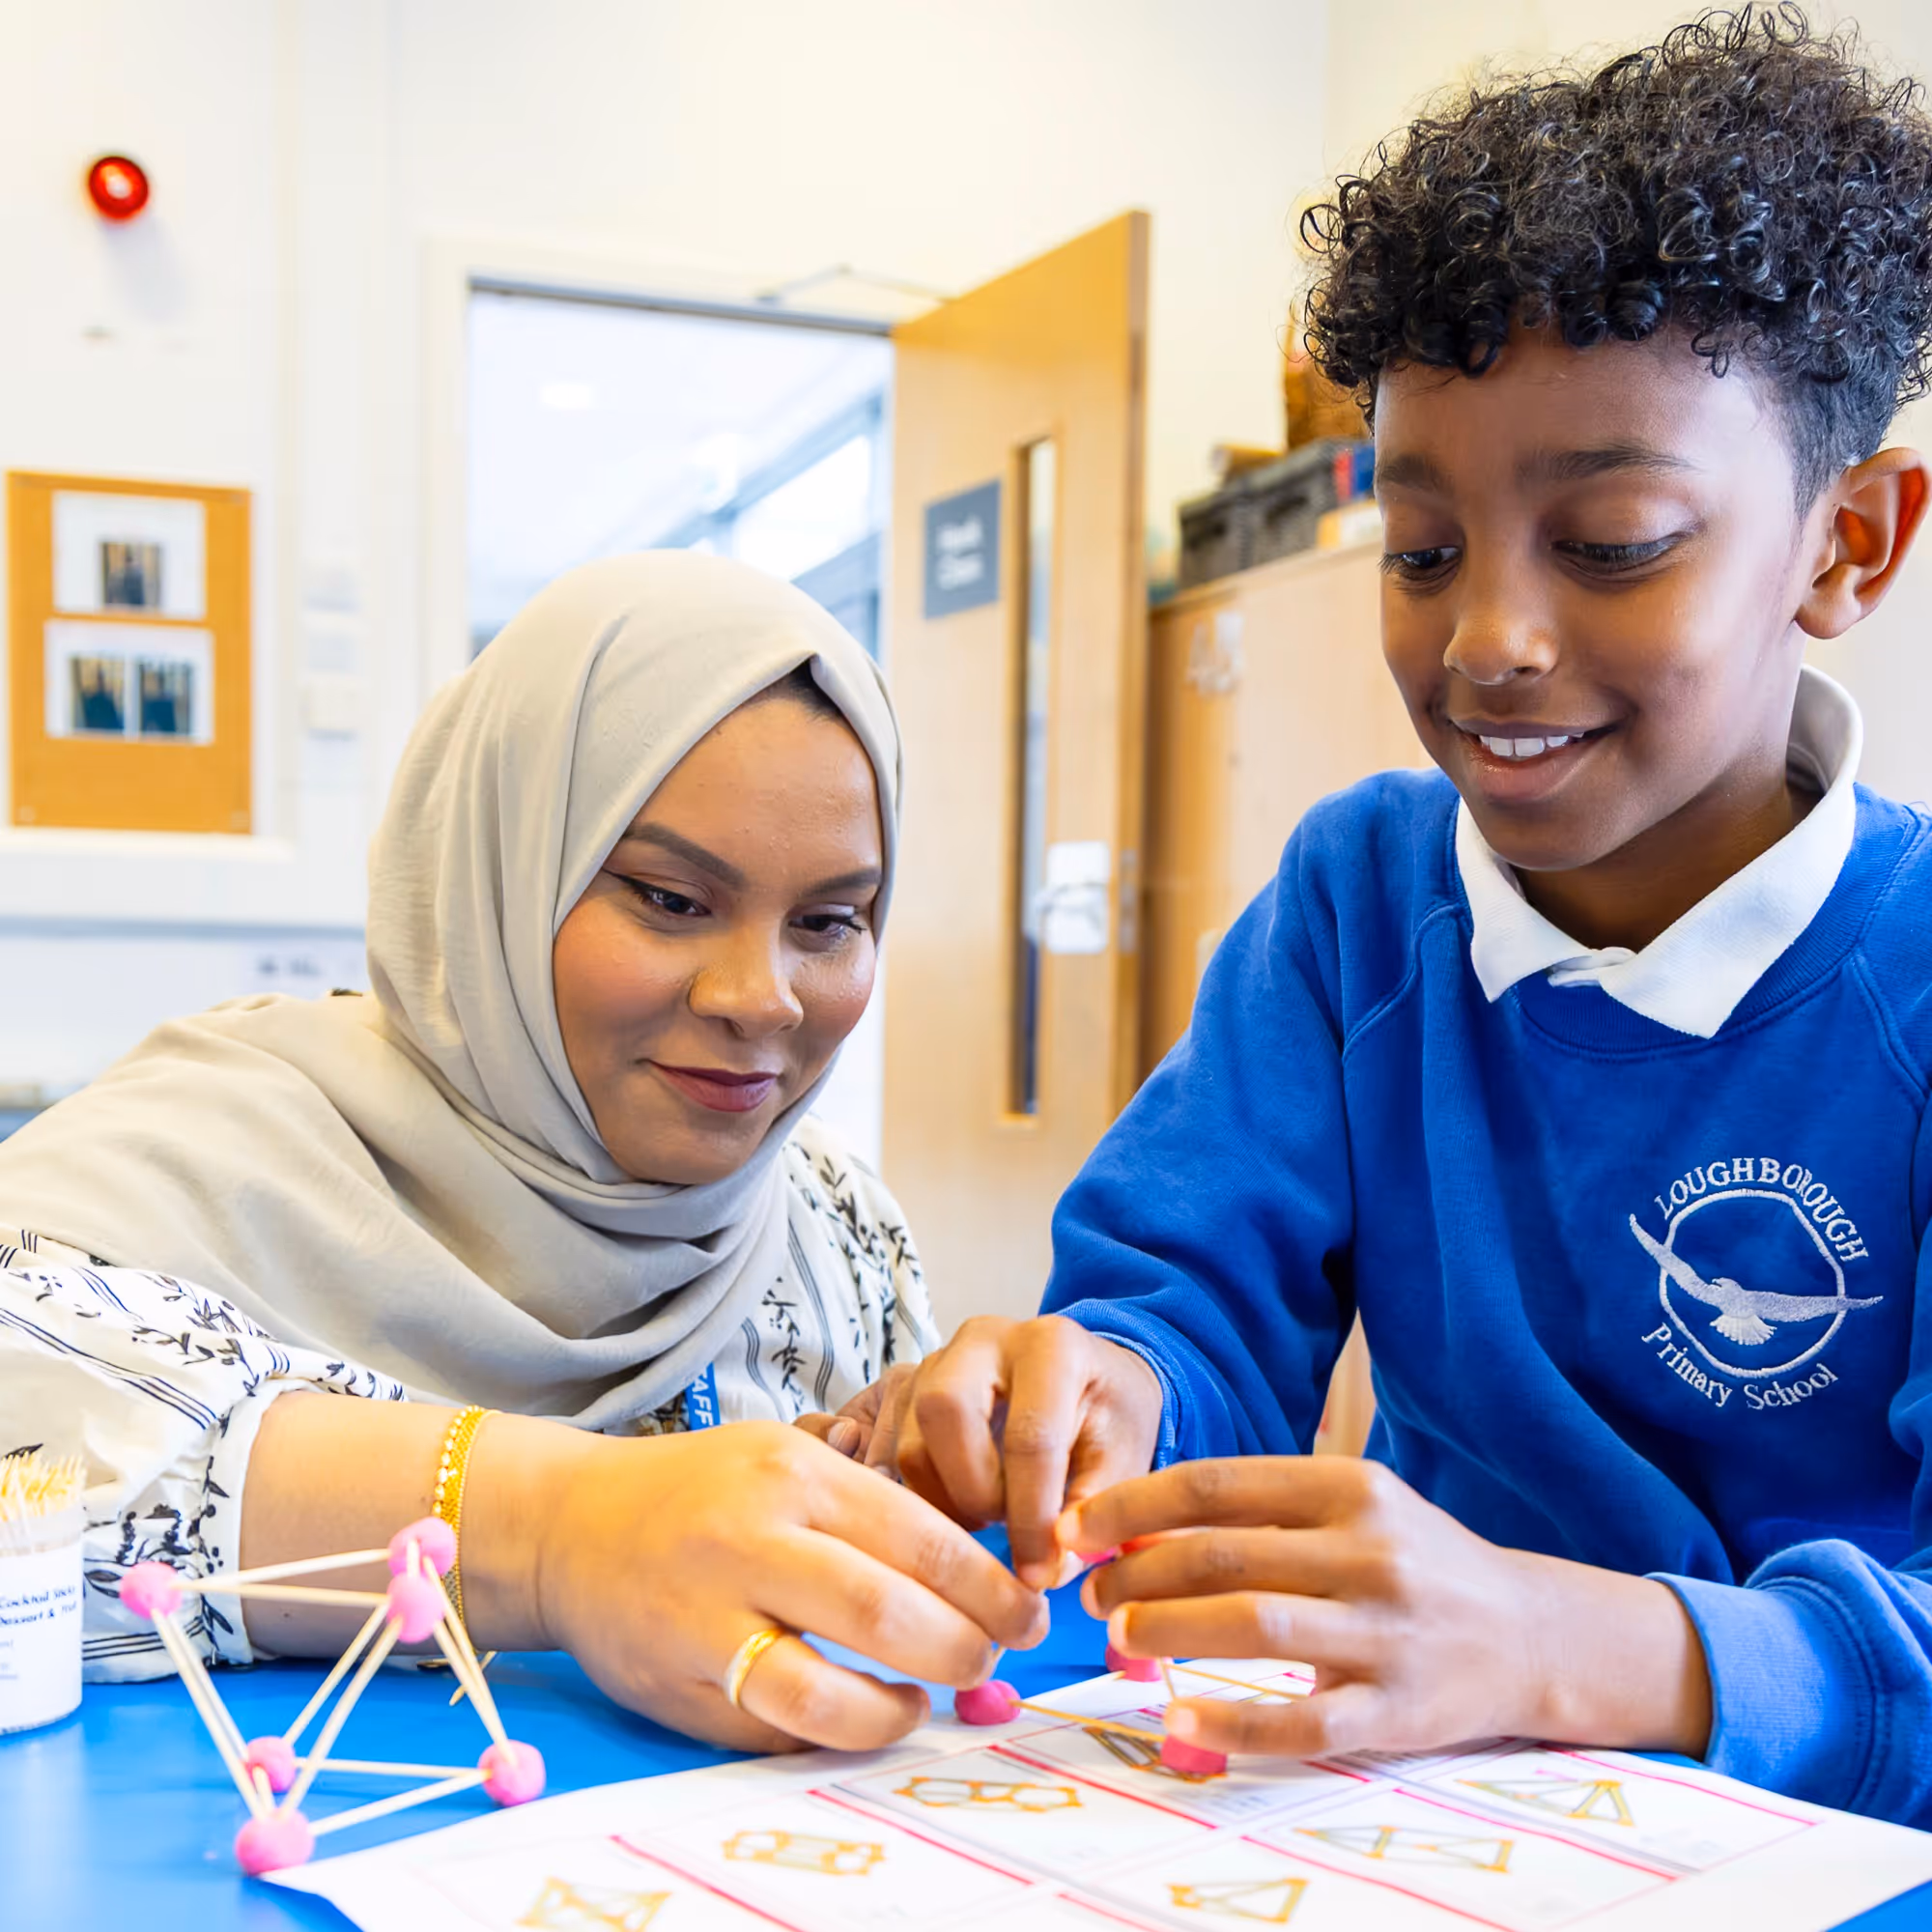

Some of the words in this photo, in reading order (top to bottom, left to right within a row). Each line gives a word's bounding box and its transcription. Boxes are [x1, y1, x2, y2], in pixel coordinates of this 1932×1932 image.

[1654, 1157, 1869, 1263] LOUGHBOROUGH
[692, 1365, 714, 1427] AFF
[1641, 1321, 1733, 1407] Primary
[1743, 1363, 1839, 1410] School
